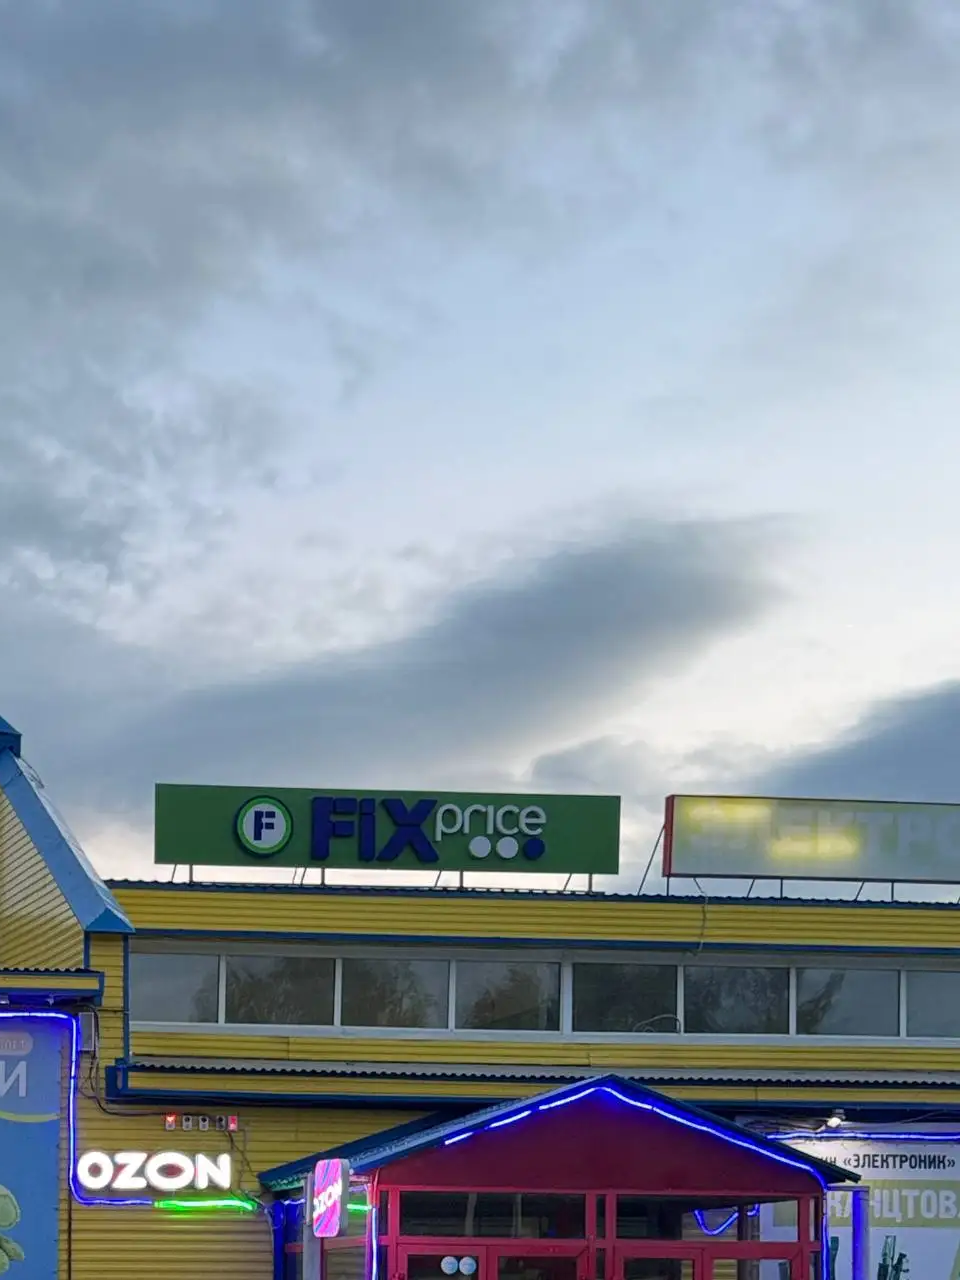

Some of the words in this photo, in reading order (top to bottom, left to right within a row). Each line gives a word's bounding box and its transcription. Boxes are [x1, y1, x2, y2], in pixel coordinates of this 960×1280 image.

[435, 804, 547, 842] price
[77, 1151, 232, 1191] OZON
[843, 1153, 956, 1170] «ЭЛЕКТРОНИК»
